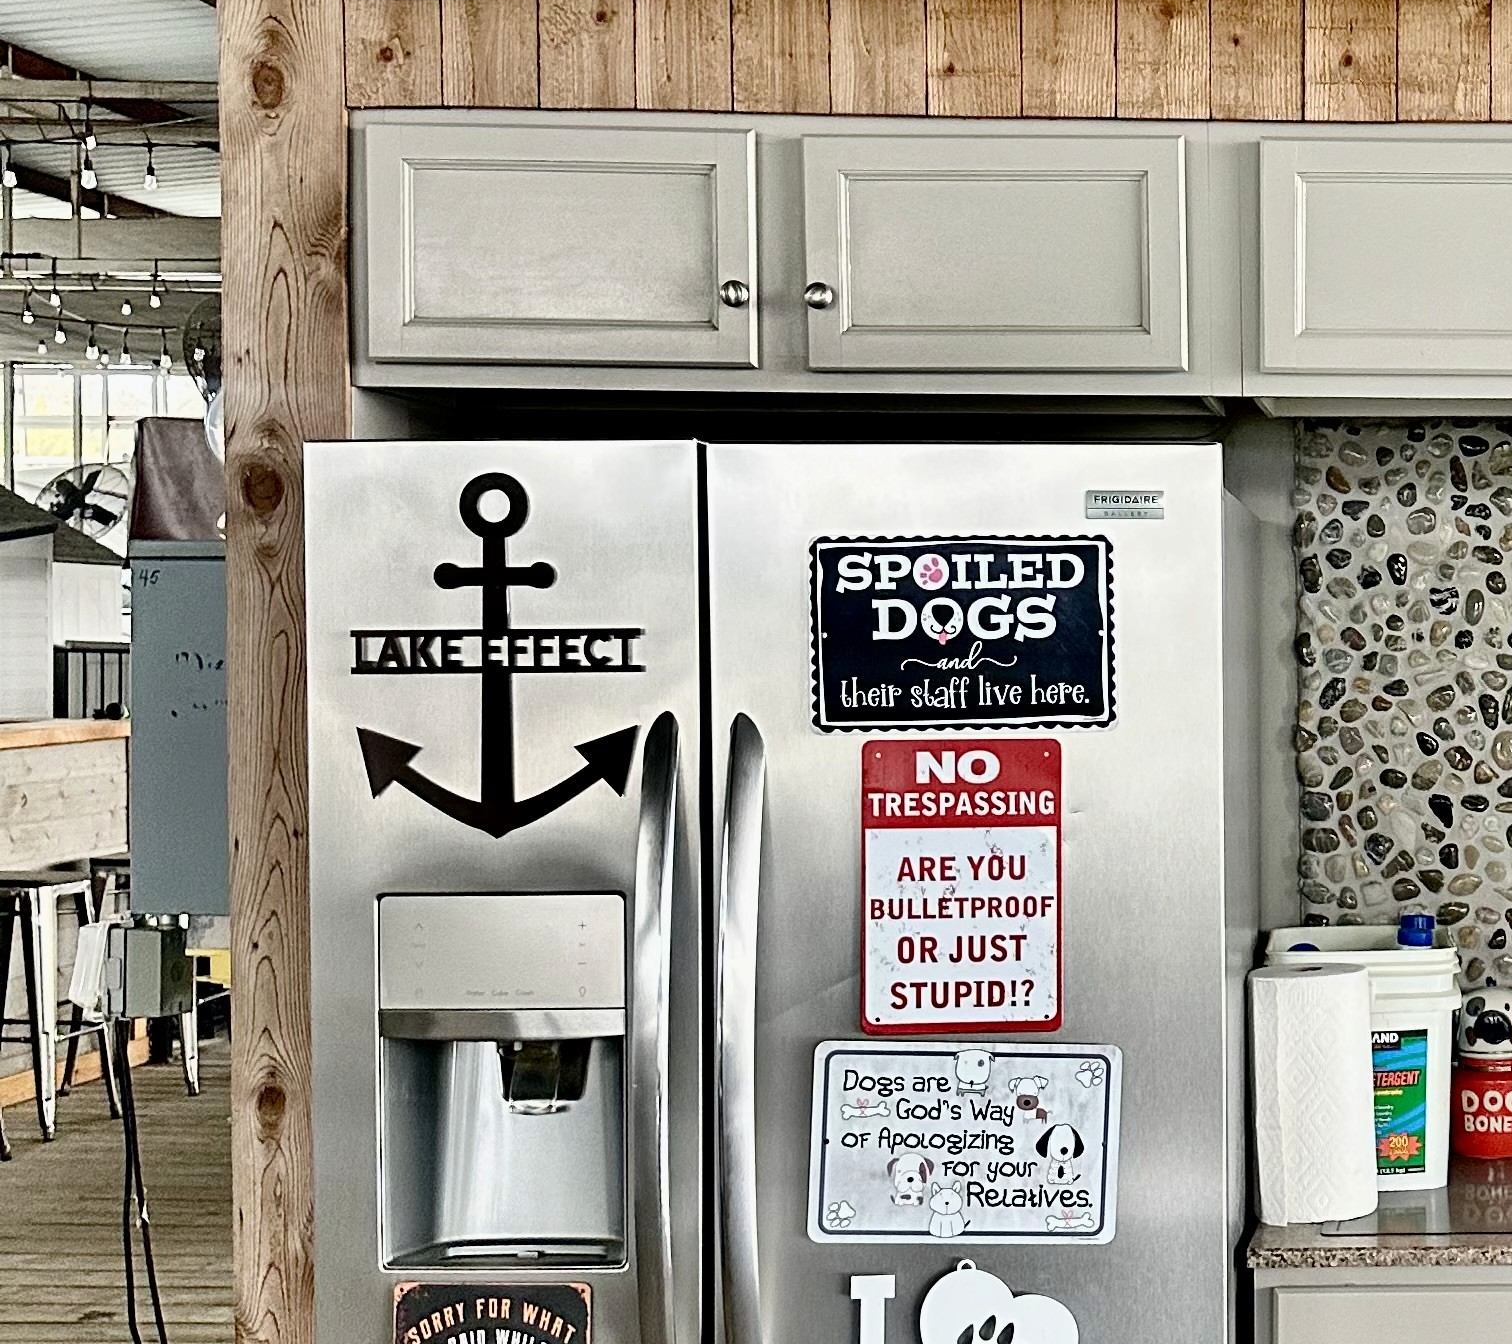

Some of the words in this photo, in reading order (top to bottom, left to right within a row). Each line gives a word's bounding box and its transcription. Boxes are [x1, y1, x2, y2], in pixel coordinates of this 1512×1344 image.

[1093, 495, 1159, 504] FRIGIDAIRE
[139, 568, 161, 587] 45
[835, 551, 1085, 593] SPOILED
[871, 593, 1057, 644] DOGS
[354, 632, 464, 671] LAKE
[481, 630, 645, 670] EFFECT
[840, 677, 903, 708] their
[910, 676, 970, 709] staff
[978, 675, 1022, 706] live
[1030, 674, 1090, 705] here.
[915, 749, 1000, 785] NO
[867, 790, 1055, 817] TRESPASSING
[896, 856, 957, 882] ARE
[967, 854, 1026, 881] YOU
[869, 895, 1055, 920] BULLETPROOF
[897, 936, 938, 963] OR
[949, 934, 1027, 963] JUST
[890, 978, 1035, 1009] STUPID!?
[842, 1069, 904, 1097] Dogs
[912, 1076, 951, 1093] are
[1374, 1070, 1420, 1087] TERGENT
[970, 1099, 1015, 1126] Way
[877, 1127, 1015, 1155] Apologizing
[1389, 1136, 1409, 1147] 200
[987, 1160, 1038, 1182] your
[966, 1182, 1094, 1208] Relatives.
[475, 1297, 510, 1320] FOR
[522, 1301, 577, 1344] WHAT
